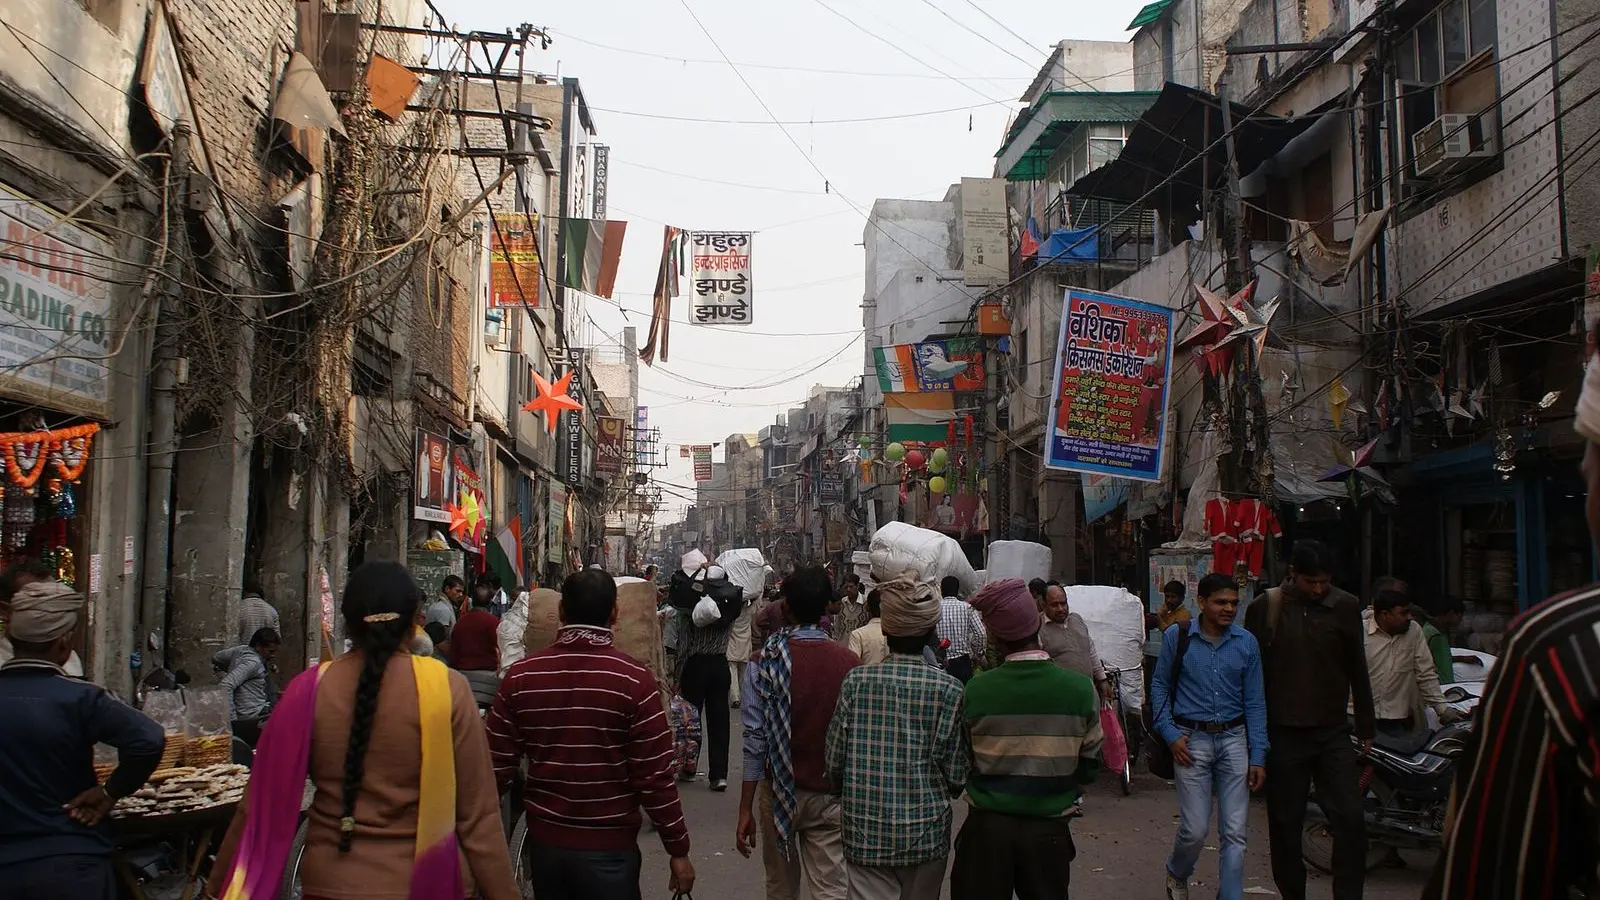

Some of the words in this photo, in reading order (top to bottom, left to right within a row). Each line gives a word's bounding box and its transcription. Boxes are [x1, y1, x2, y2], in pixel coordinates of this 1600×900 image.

[596, 150, 606, 197] BHAGWAN
[692, 233, 750, 253] राहुल
[695, 272, 749, 296] झण्डे
[694, 299, 749, 322] झण्डे
[1070, 301, 1128, 345] वंशिका
[1067, 338, 1104, 371] क्रिसमस
